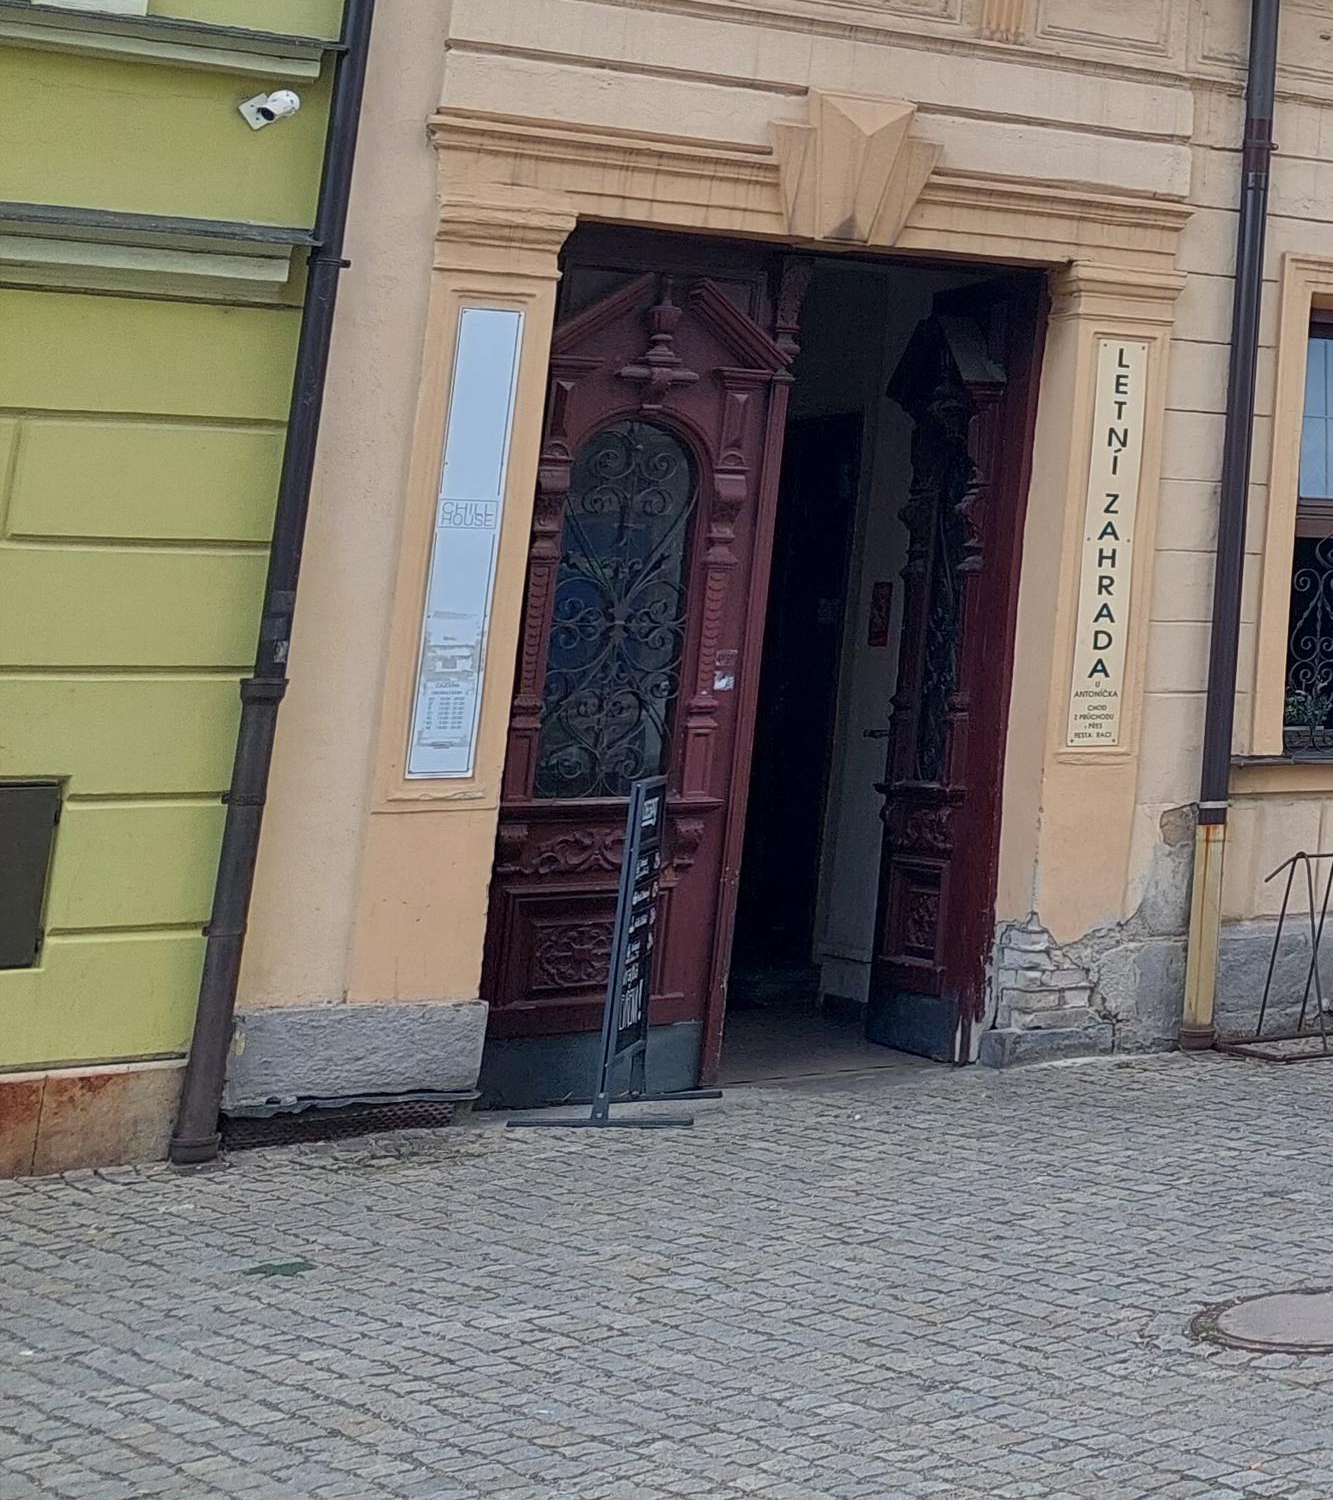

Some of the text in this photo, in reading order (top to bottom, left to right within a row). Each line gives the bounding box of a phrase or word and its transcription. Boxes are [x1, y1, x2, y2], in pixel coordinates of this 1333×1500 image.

[442, 501, 494, 517] CHILL
[1087, 347, 1130, 678] LETNÍ ZAHRADA
[440, 512, 494, 527] HOUSE
[1074, 688, 1118, 698] ANTONÍČKA
